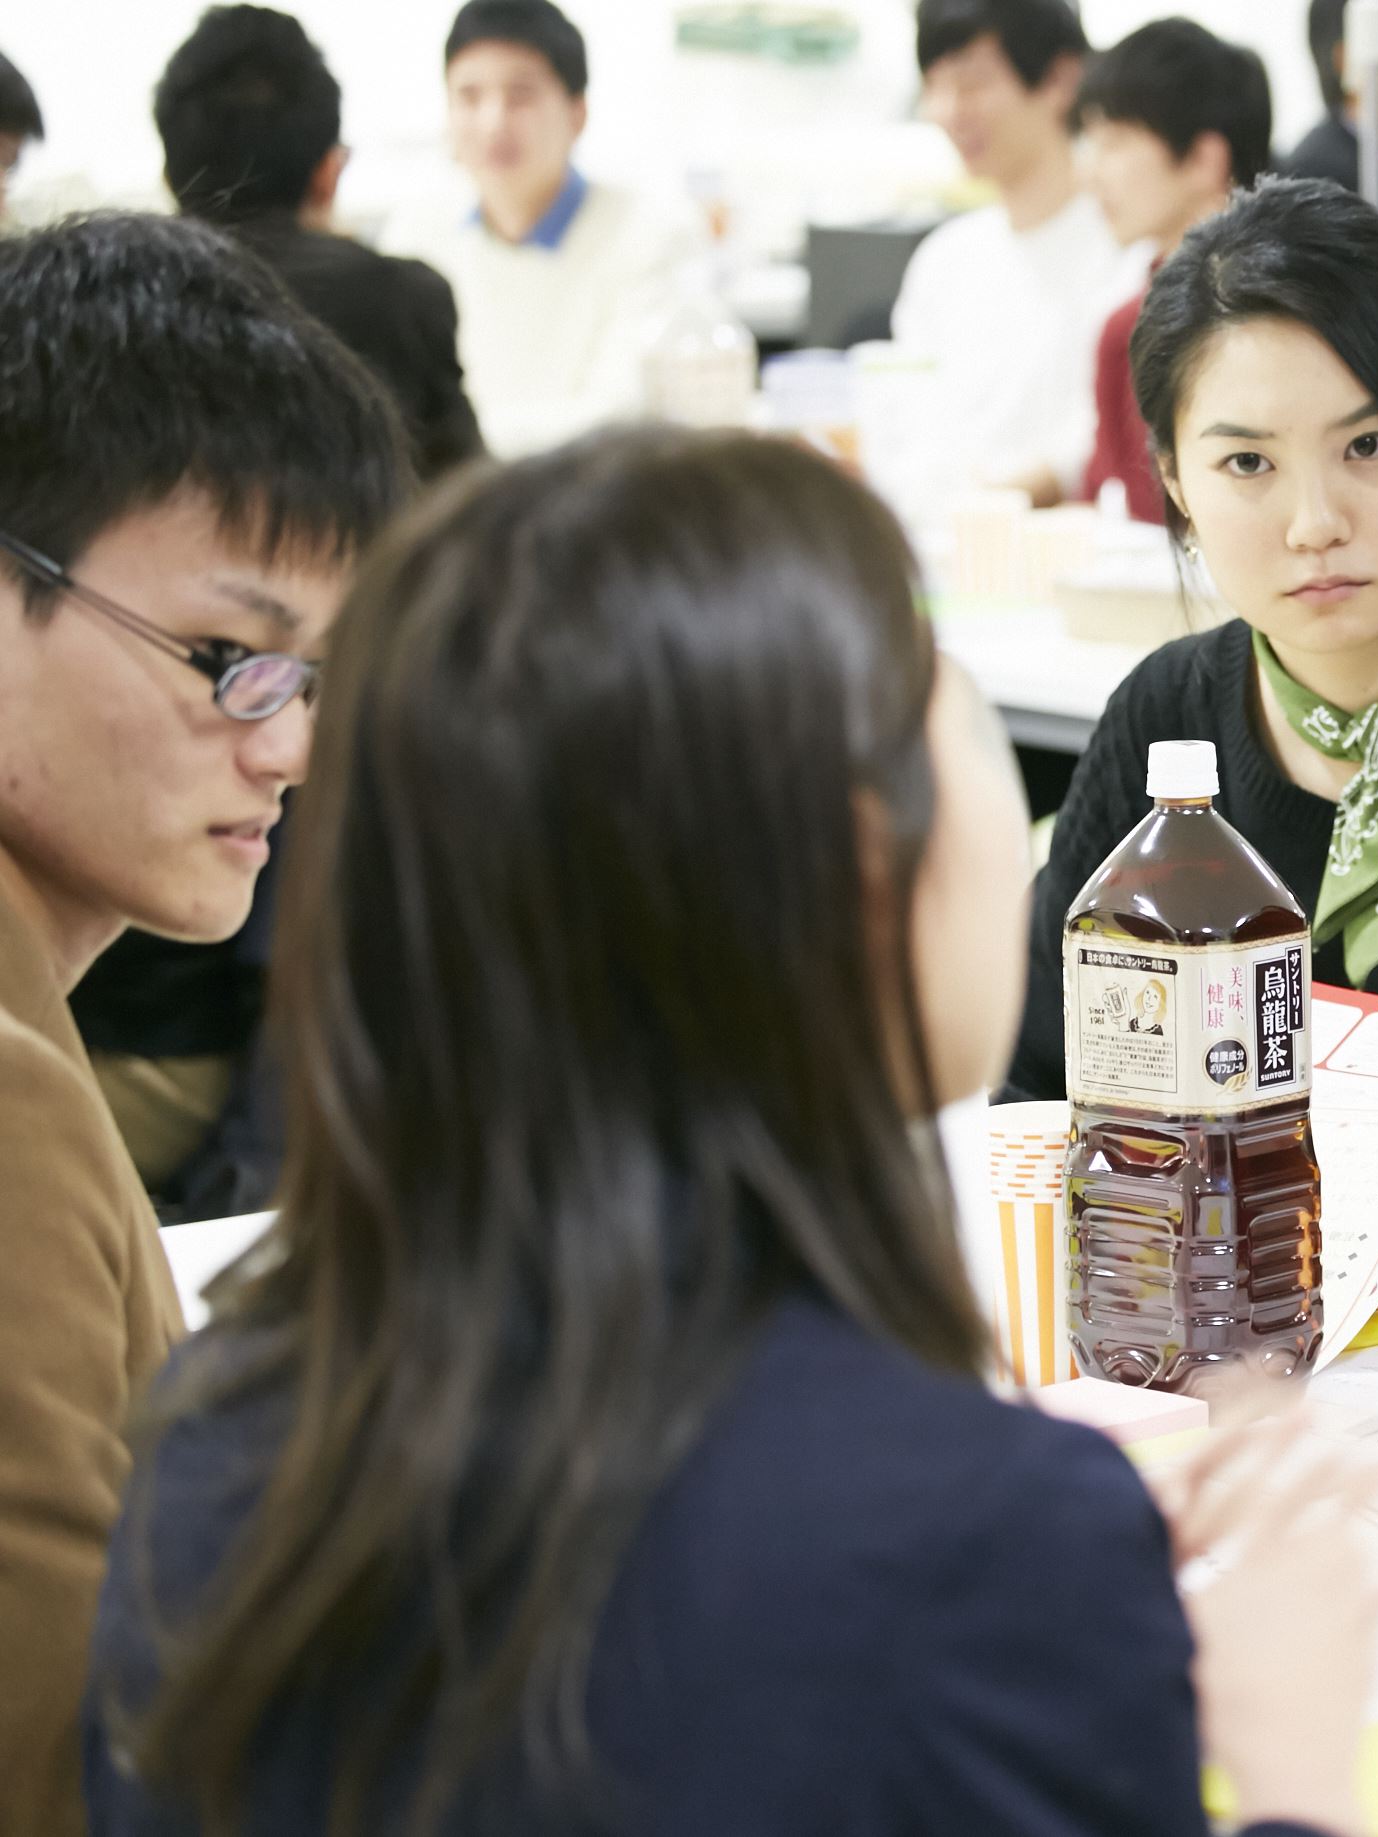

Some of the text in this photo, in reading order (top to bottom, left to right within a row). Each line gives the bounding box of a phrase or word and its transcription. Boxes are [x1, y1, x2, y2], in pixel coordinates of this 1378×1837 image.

[1288, 948, 1301, 1026] サントリー
[1207, 983, 1224, 1028] 健康
[1261, 965, 1288, 1070] 烏龍茶
[1209, 1049, 1245, 1063] 健康成分
[1209, 1062, 1245, 1075] ポリフェノール
[1260, 1069, 1291, 1082] SUNTORY
